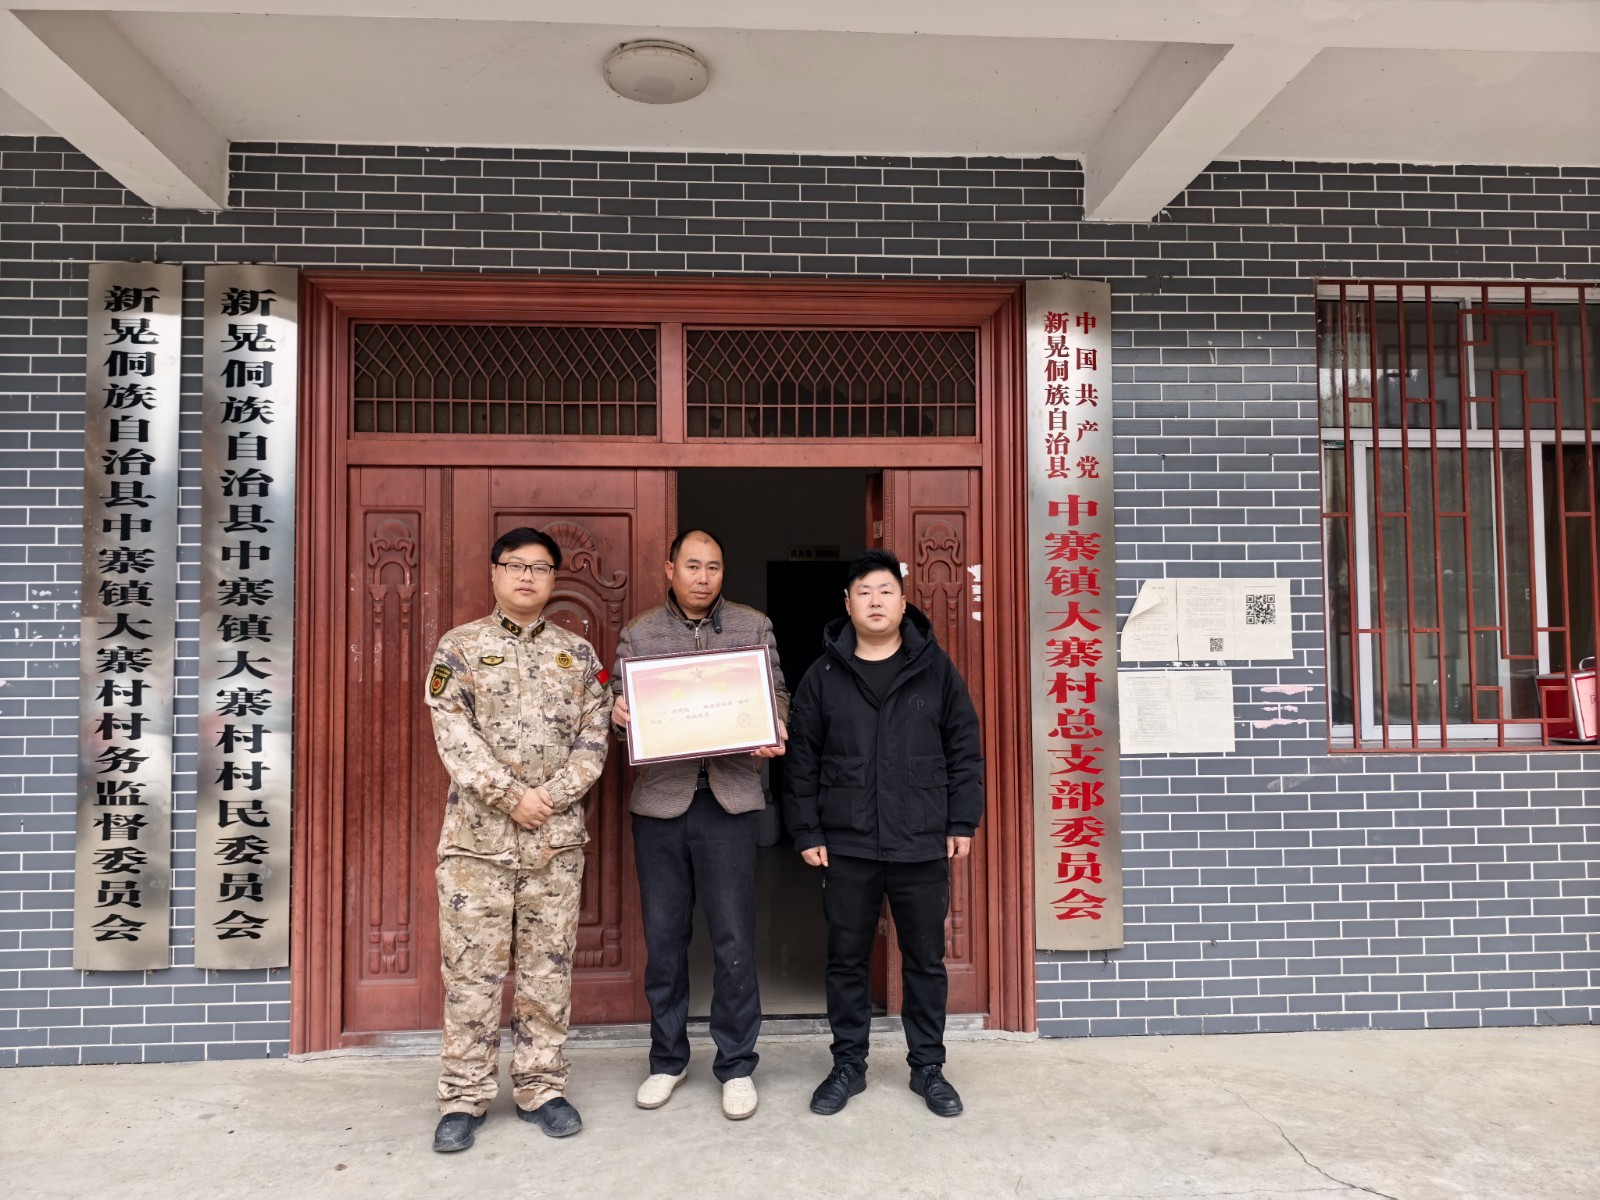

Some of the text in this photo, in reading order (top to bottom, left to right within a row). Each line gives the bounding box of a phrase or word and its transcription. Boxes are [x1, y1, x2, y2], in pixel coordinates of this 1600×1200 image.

[1044, 311, 1070, 479] 新晃侗族自治县
[1076, 311, 1100, 479] 中国共产党
[92, 285, 160, 941] 新晃侗族自治县中寨镇大寨村村务监督委员会
[214, 287, 276, 940] 新晃侗族自治县中寨镇大寨村村民委员会
[1044, 494, 1108, 920] 中寨镇大寨村总支部委员会
